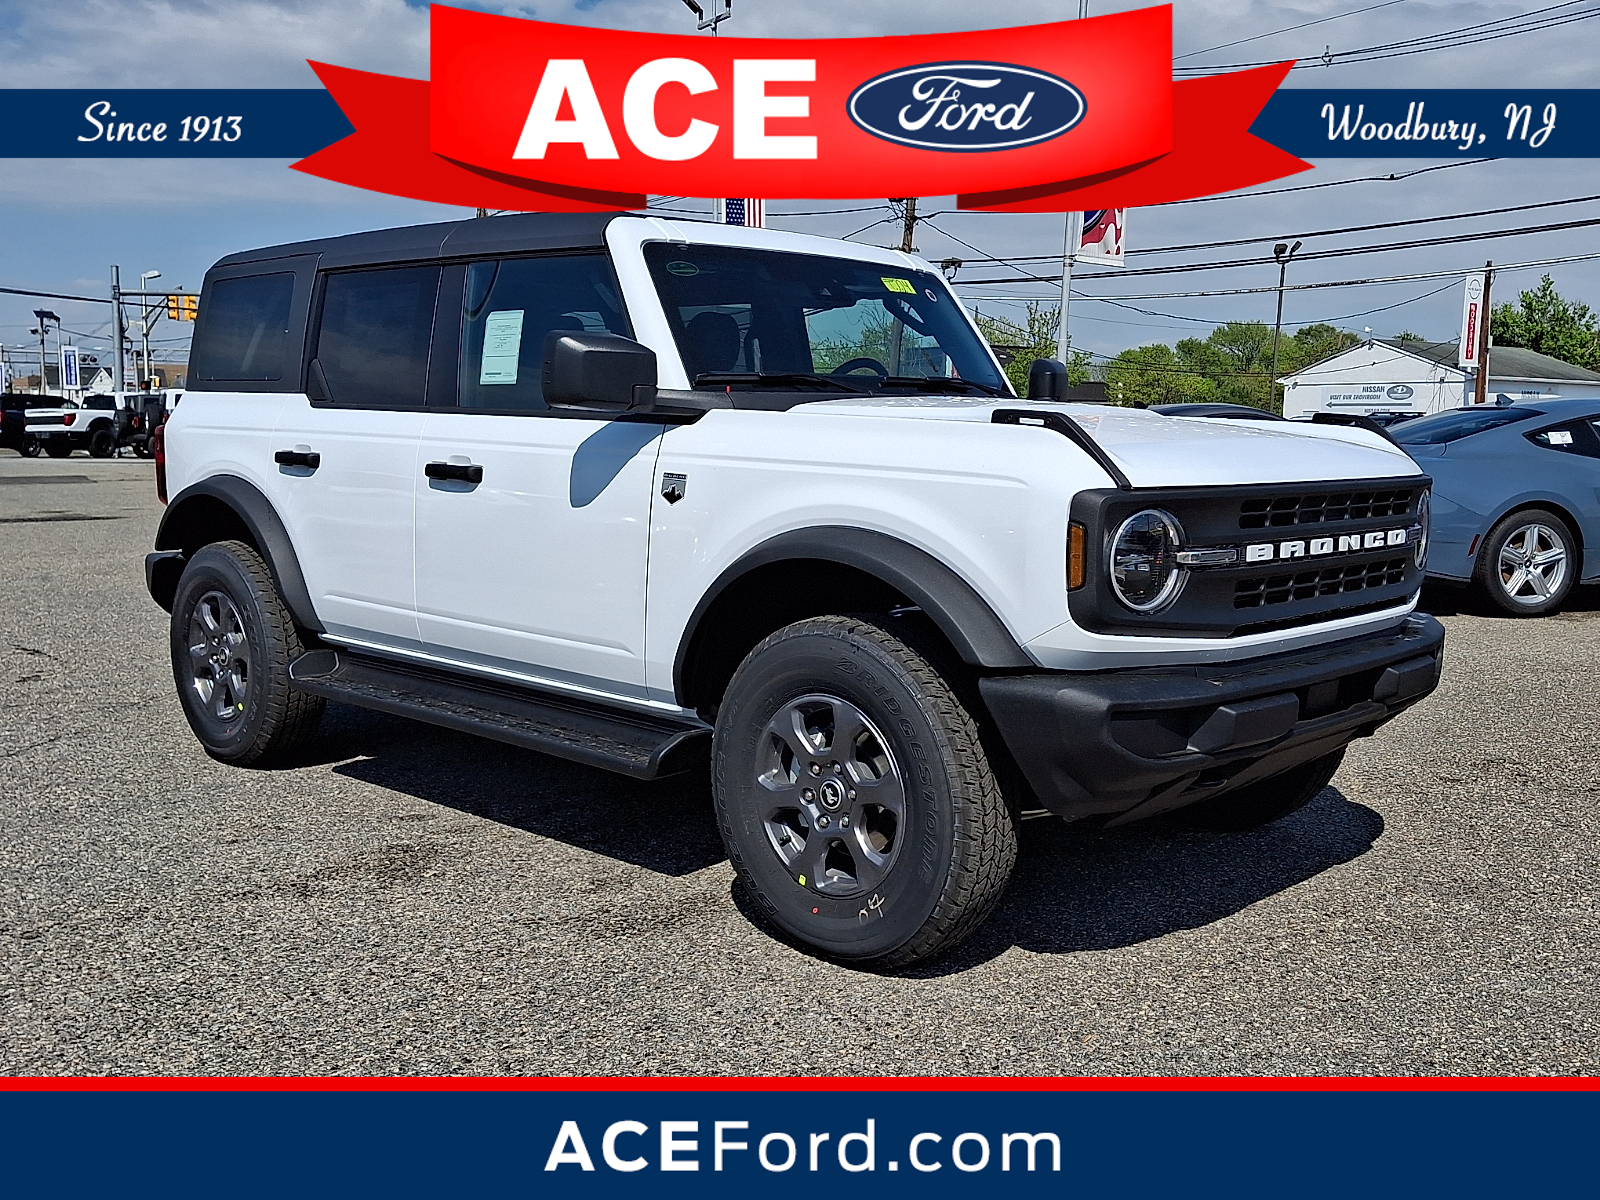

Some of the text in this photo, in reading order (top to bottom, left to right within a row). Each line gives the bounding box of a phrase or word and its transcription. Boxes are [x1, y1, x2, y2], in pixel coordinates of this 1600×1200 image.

[1362, 385, 1386, 393] NISSAN
[1245, 528, 1407, 563] BRONCO
[835, 656, 940, 886] BRIDGESTONE
